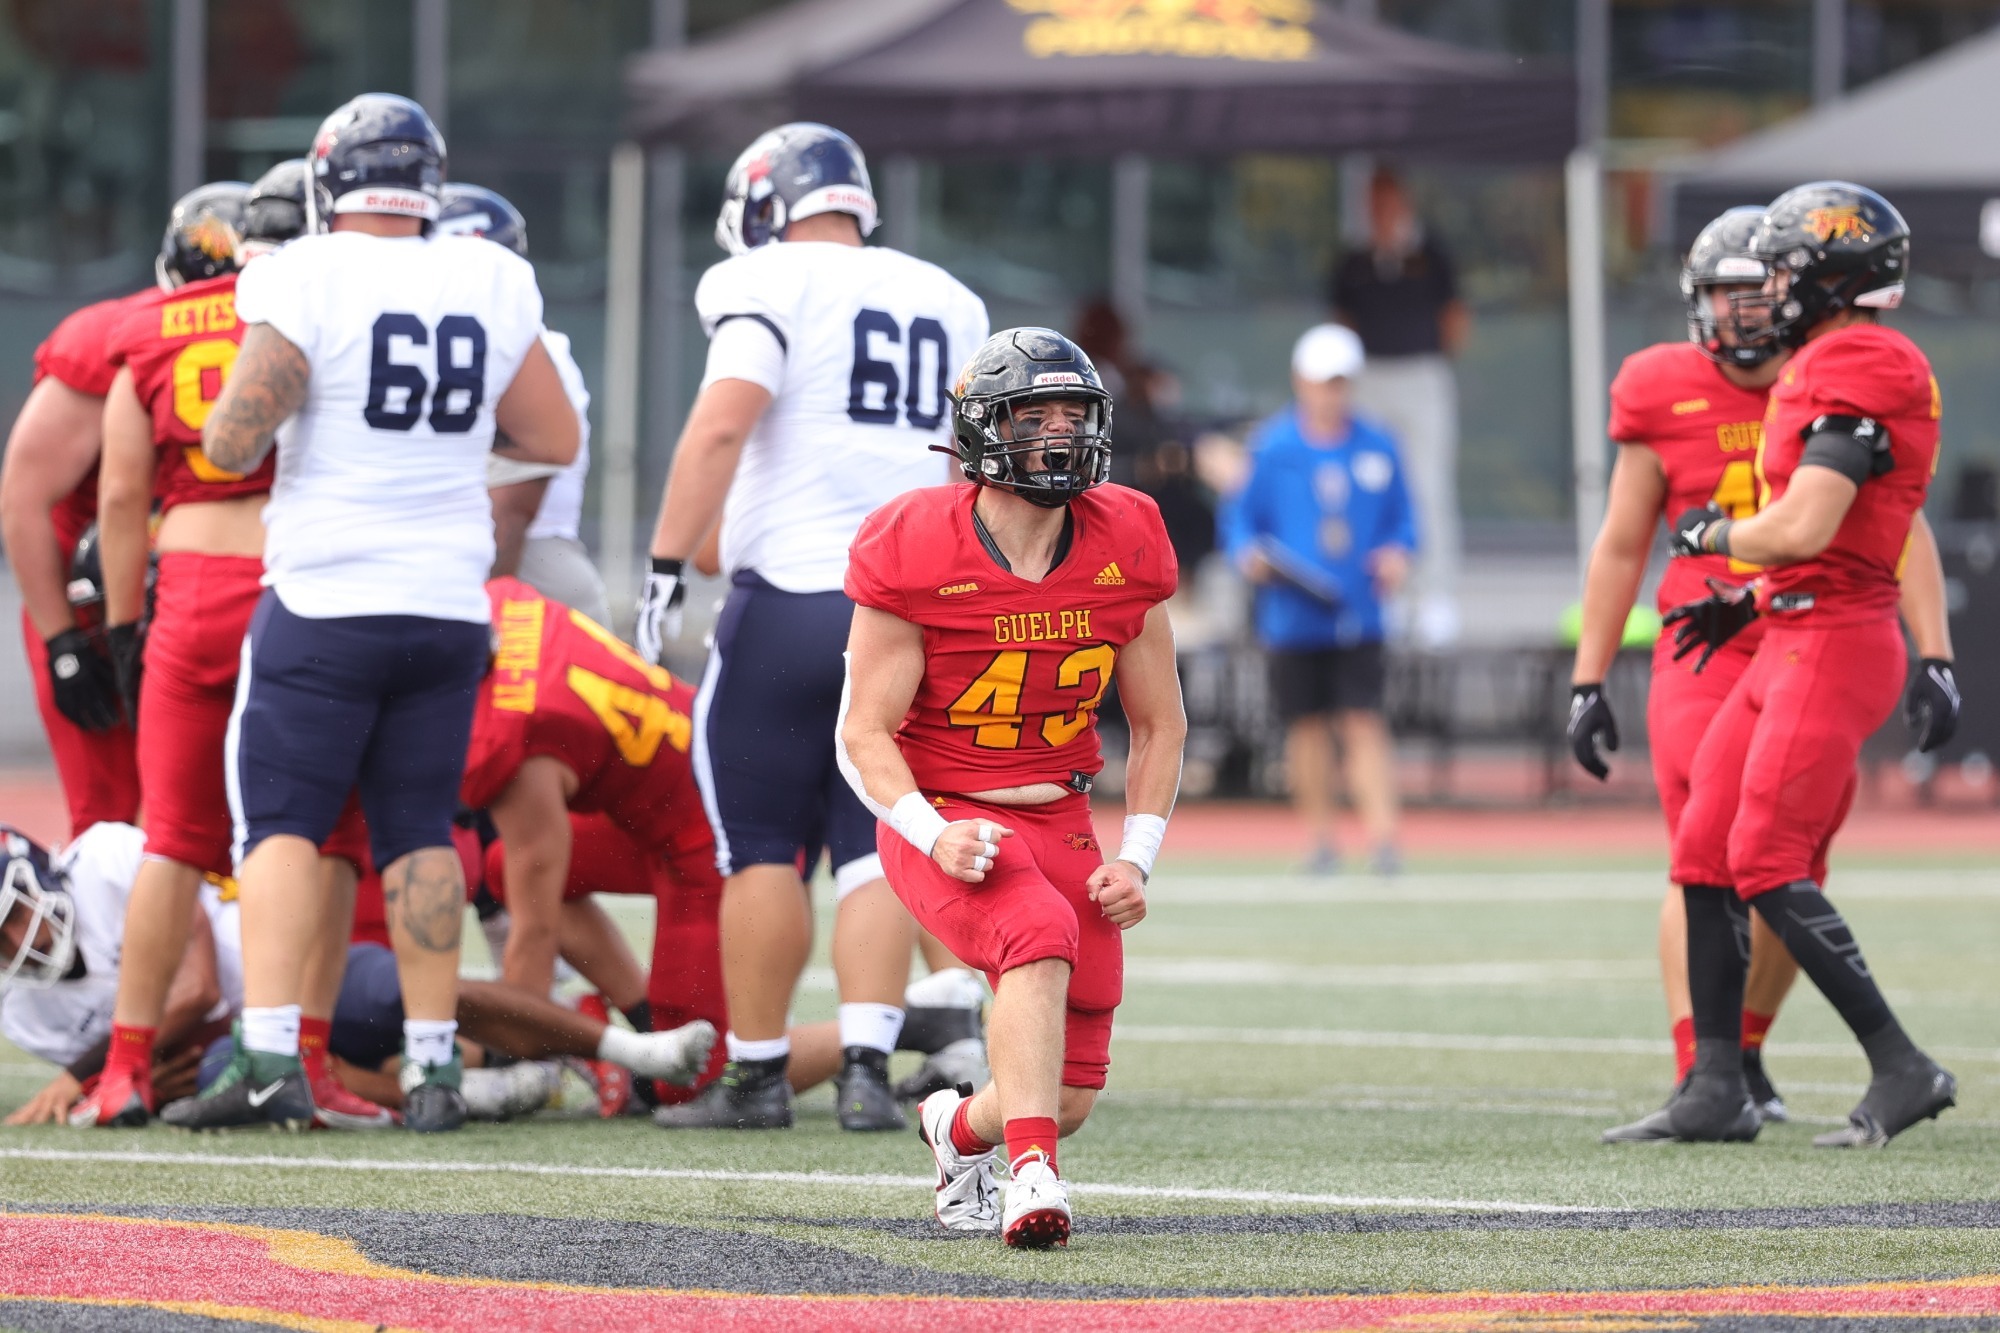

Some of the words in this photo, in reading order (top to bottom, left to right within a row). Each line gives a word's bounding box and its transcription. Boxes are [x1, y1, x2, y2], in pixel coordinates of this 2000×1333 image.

[161, 291, 237, 338] KEYES
[363, 312, 487, 433] 68
[846, 308, 948, 431] 60
[1041, 374, 1078, 384] Riddell
[1712, 460, 1766, 575] 4
[938, 582, 979, 596] OUA
[1093, 575, 1126, 586] adidas
[994, 609, 1092, 643] GUELPH
[945, 642, 1117, 749] 43
